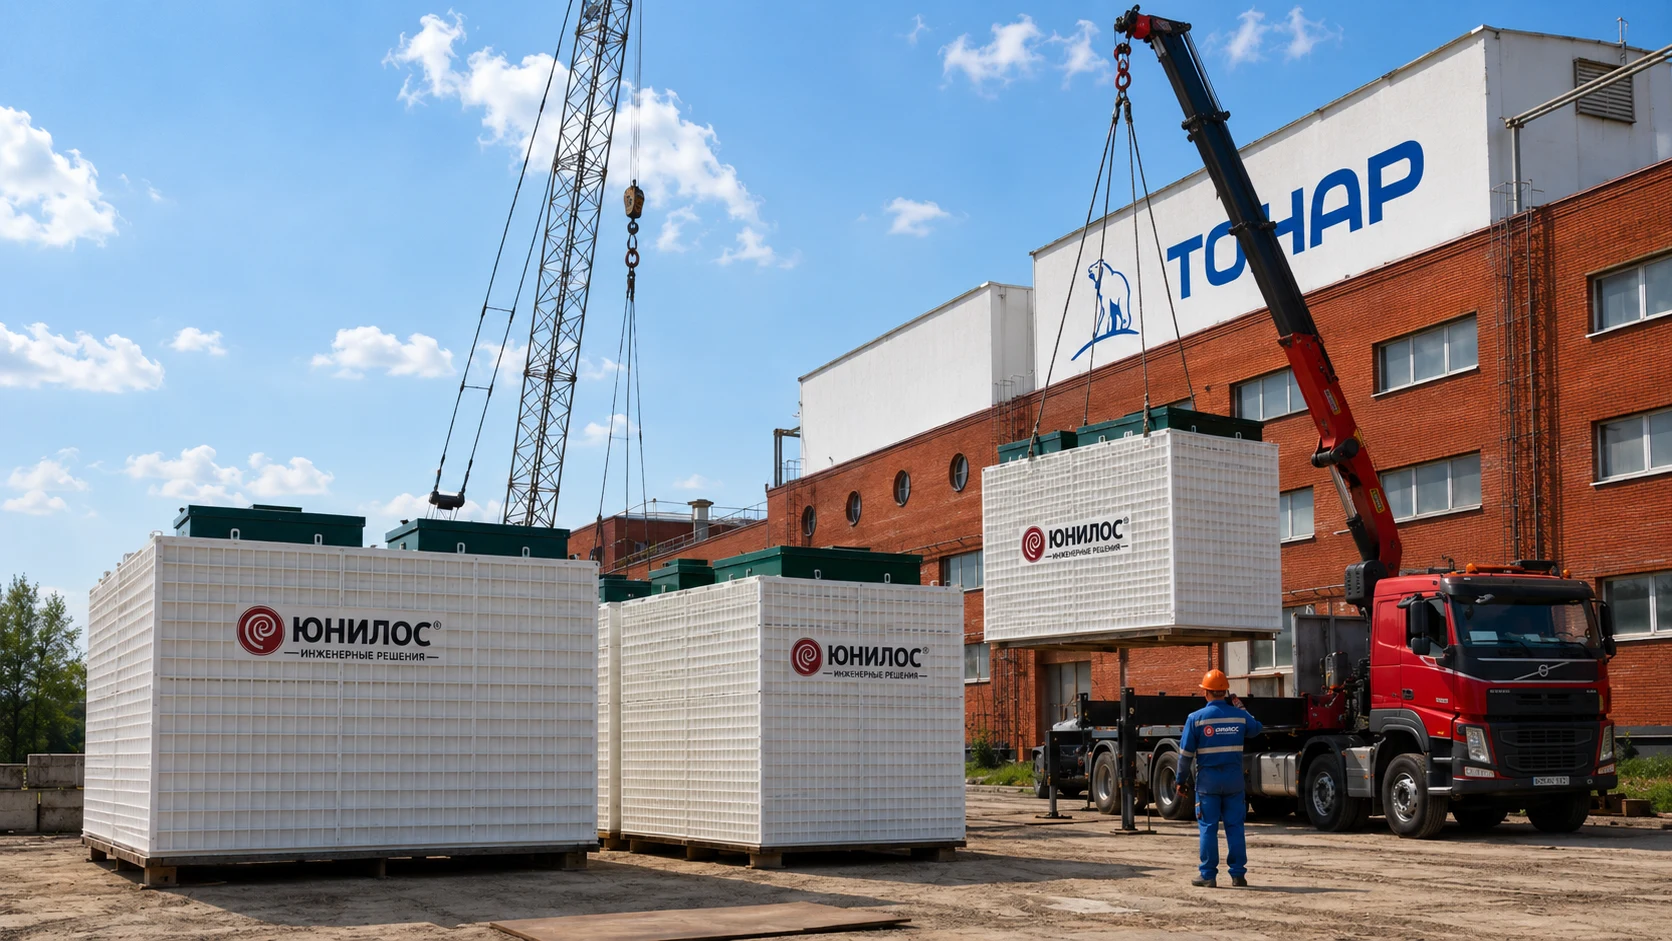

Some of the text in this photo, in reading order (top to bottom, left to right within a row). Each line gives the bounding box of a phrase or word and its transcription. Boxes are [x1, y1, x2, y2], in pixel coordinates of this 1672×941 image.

[1166, 140, 1424, 300] ТОНАР
[300, 649, 425, 661] ИНЖЕНЕРНЫЕ РЕШЕНИЯ
